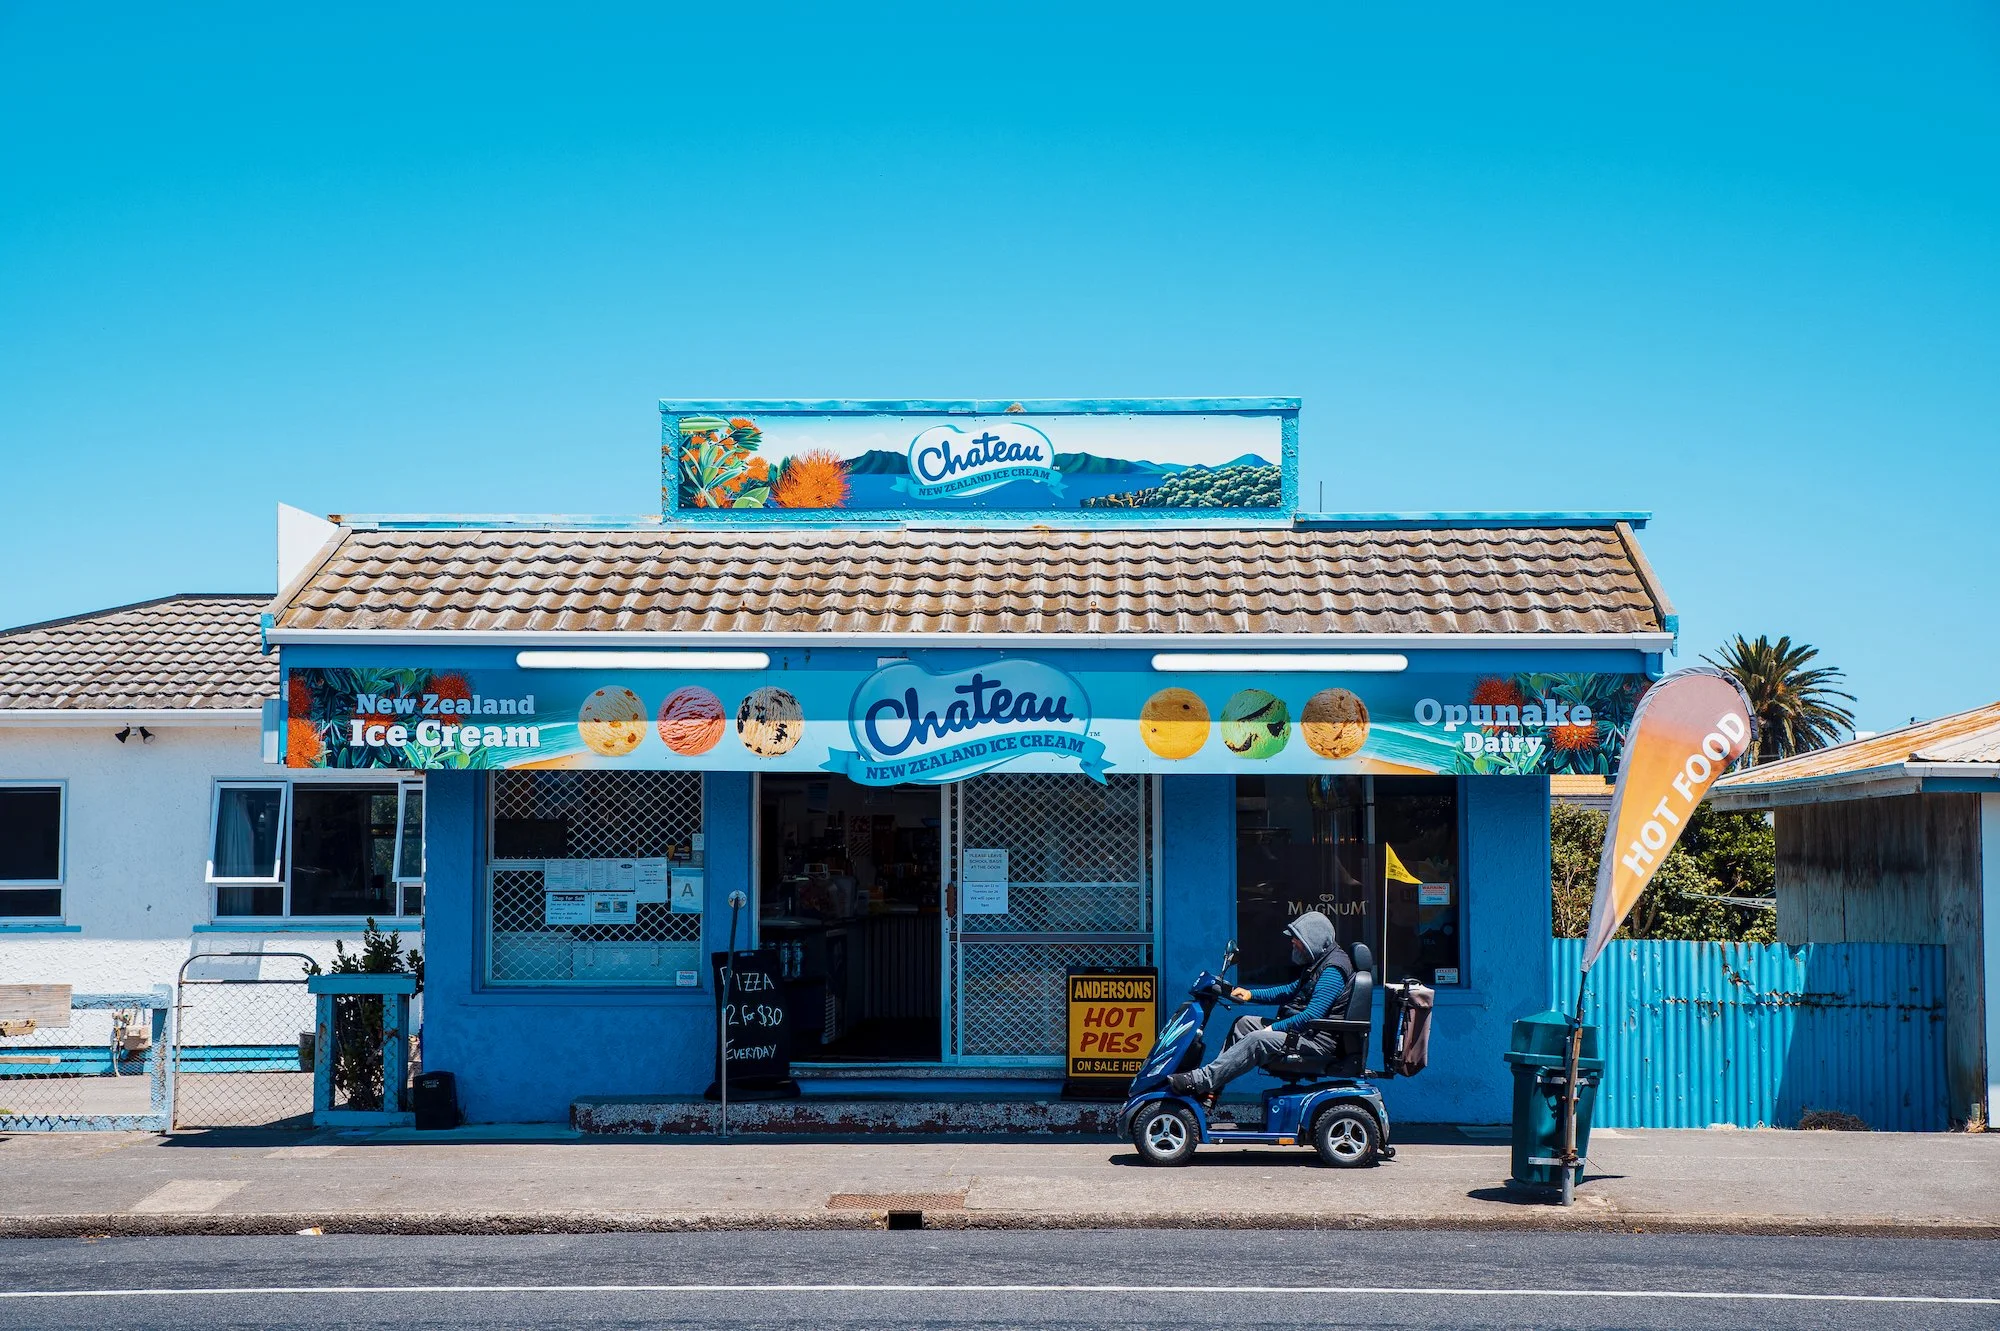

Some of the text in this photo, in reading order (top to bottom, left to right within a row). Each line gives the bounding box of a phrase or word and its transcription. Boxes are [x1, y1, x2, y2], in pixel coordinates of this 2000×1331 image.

[918, 432, 1044, 482] Chateau
[918, 468, 1050, 496] NEW ZEALAND ICE CREAM
[356, 693, 535, 715] New Zealand
[865, 673, 1074, 756] Chateau
[1414, 698, 1592, 732] Opunake
[350, 719, 541, 748] Ice Cream
[1462, 732, 1542, 756] Dairy
[866, 735, 1084, 780] NEW ZEALAND ICE CREAM
[1622, 712, 1744, 878] HOT FOOD
[682, 883, 694, 897] A
[1288, 901, 1367, 915] MAGNUM
[720, 966, 774, 991] PIZZA
[1074, 981, 1151, 999] ANDERSONS
[726, 1004, 739, 1025] 2
[758, 1004, 782, 1026] $30
[1084, 1007, 1145, 1028] HOT
[1080, 1032, 1143, 1053] PIES
[1077, 1061, 1143, 1071] ON SALE HER
